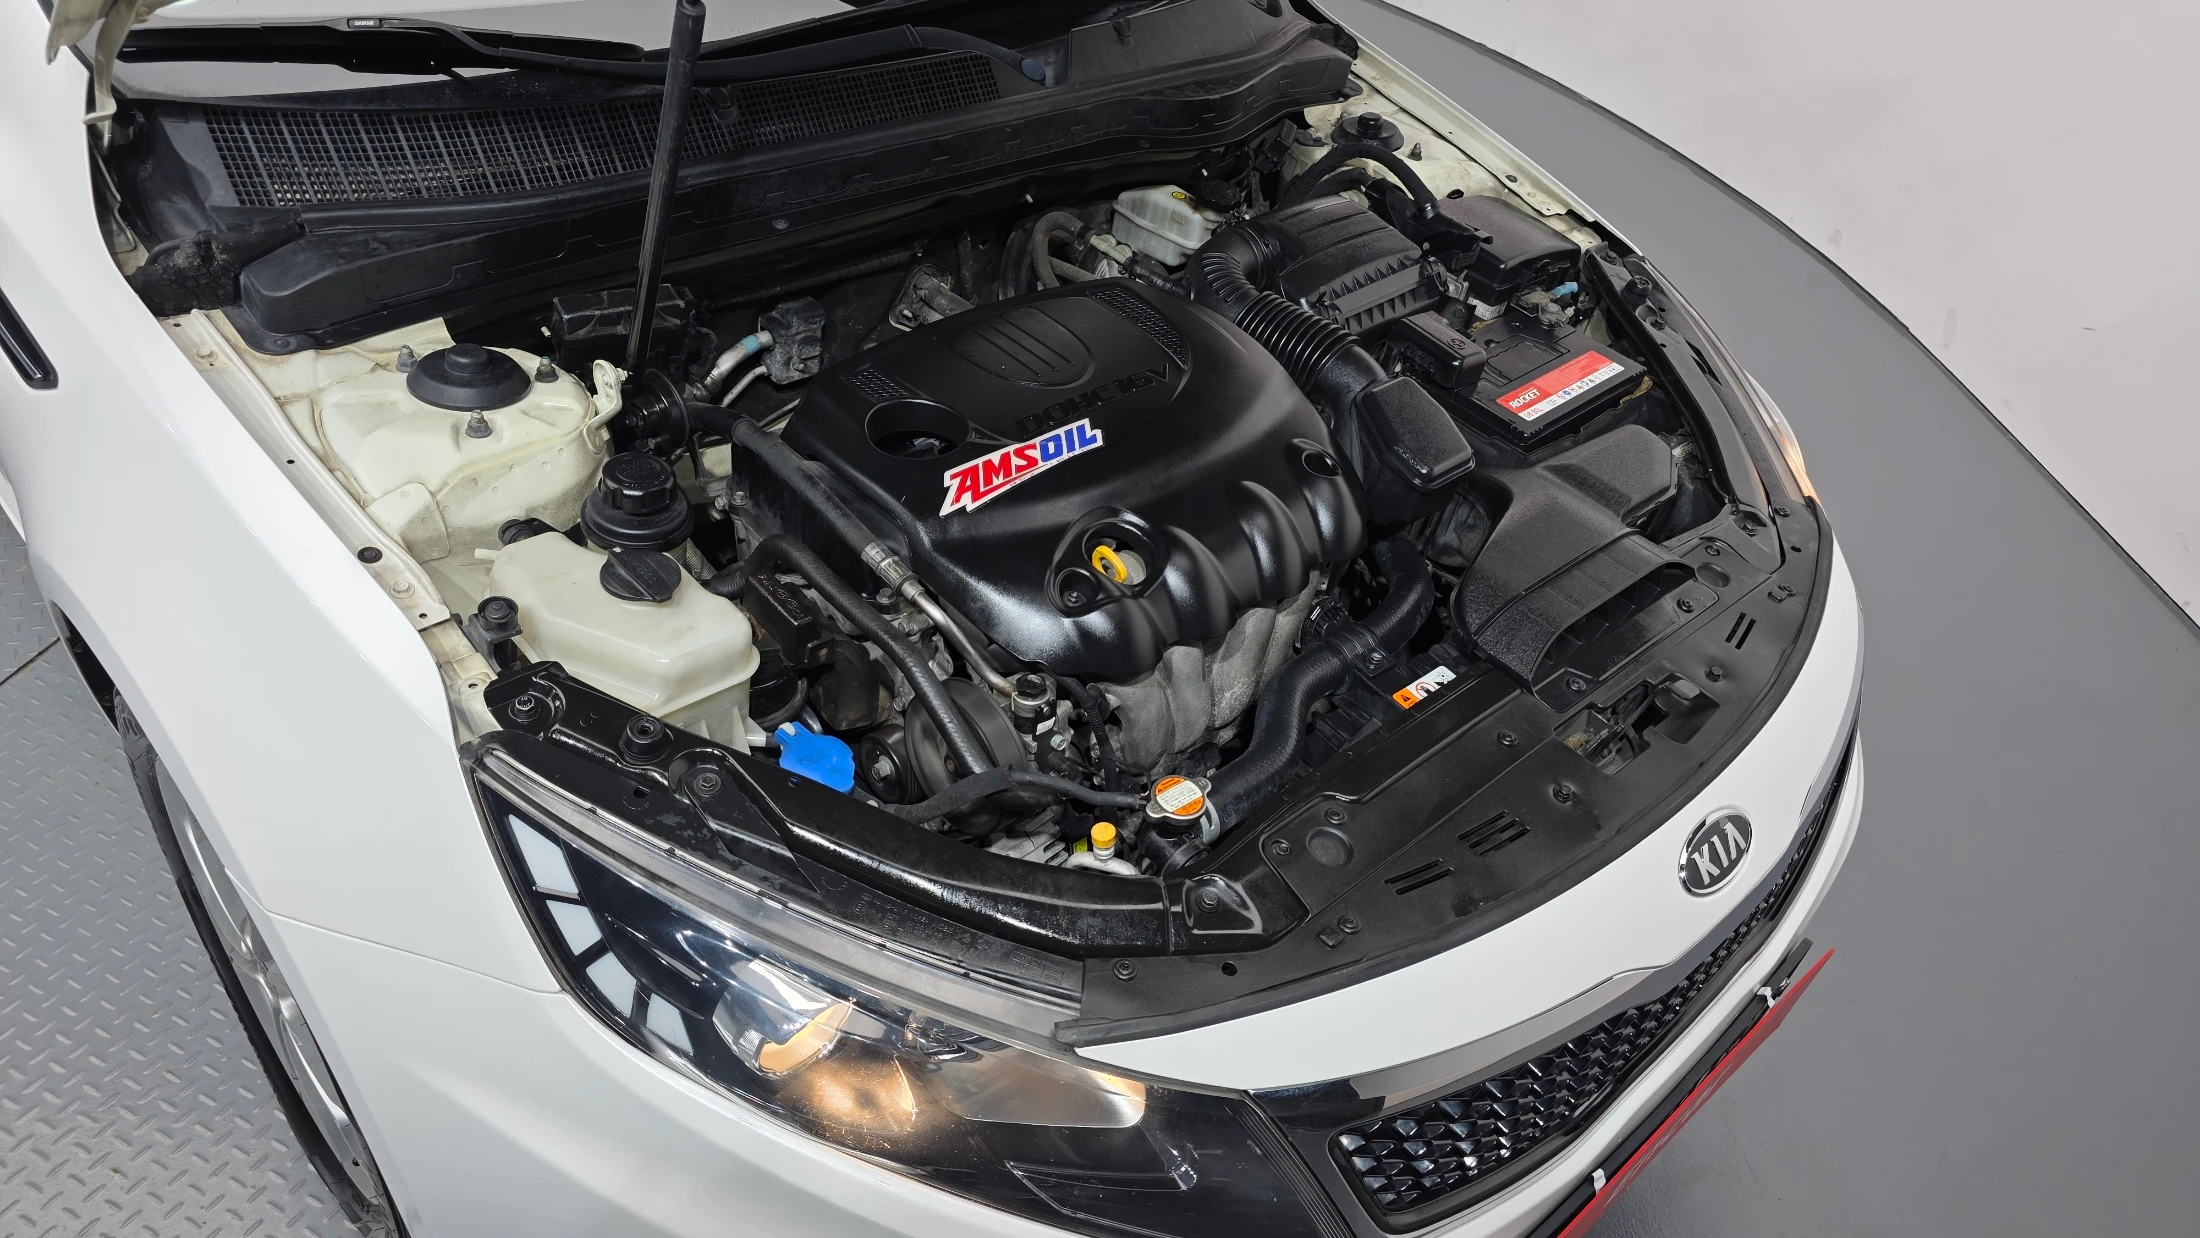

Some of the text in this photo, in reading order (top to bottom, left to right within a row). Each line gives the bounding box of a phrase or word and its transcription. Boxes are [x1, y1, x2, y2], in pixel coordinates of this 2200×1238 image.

[1014, 363, 1170, 440] DOHC 16V
[1508, 388, 1541, 409] ROCKET
[949, 423, 1098, 508] AMSOIL
[1690, 821, 1747, 886] KIA
